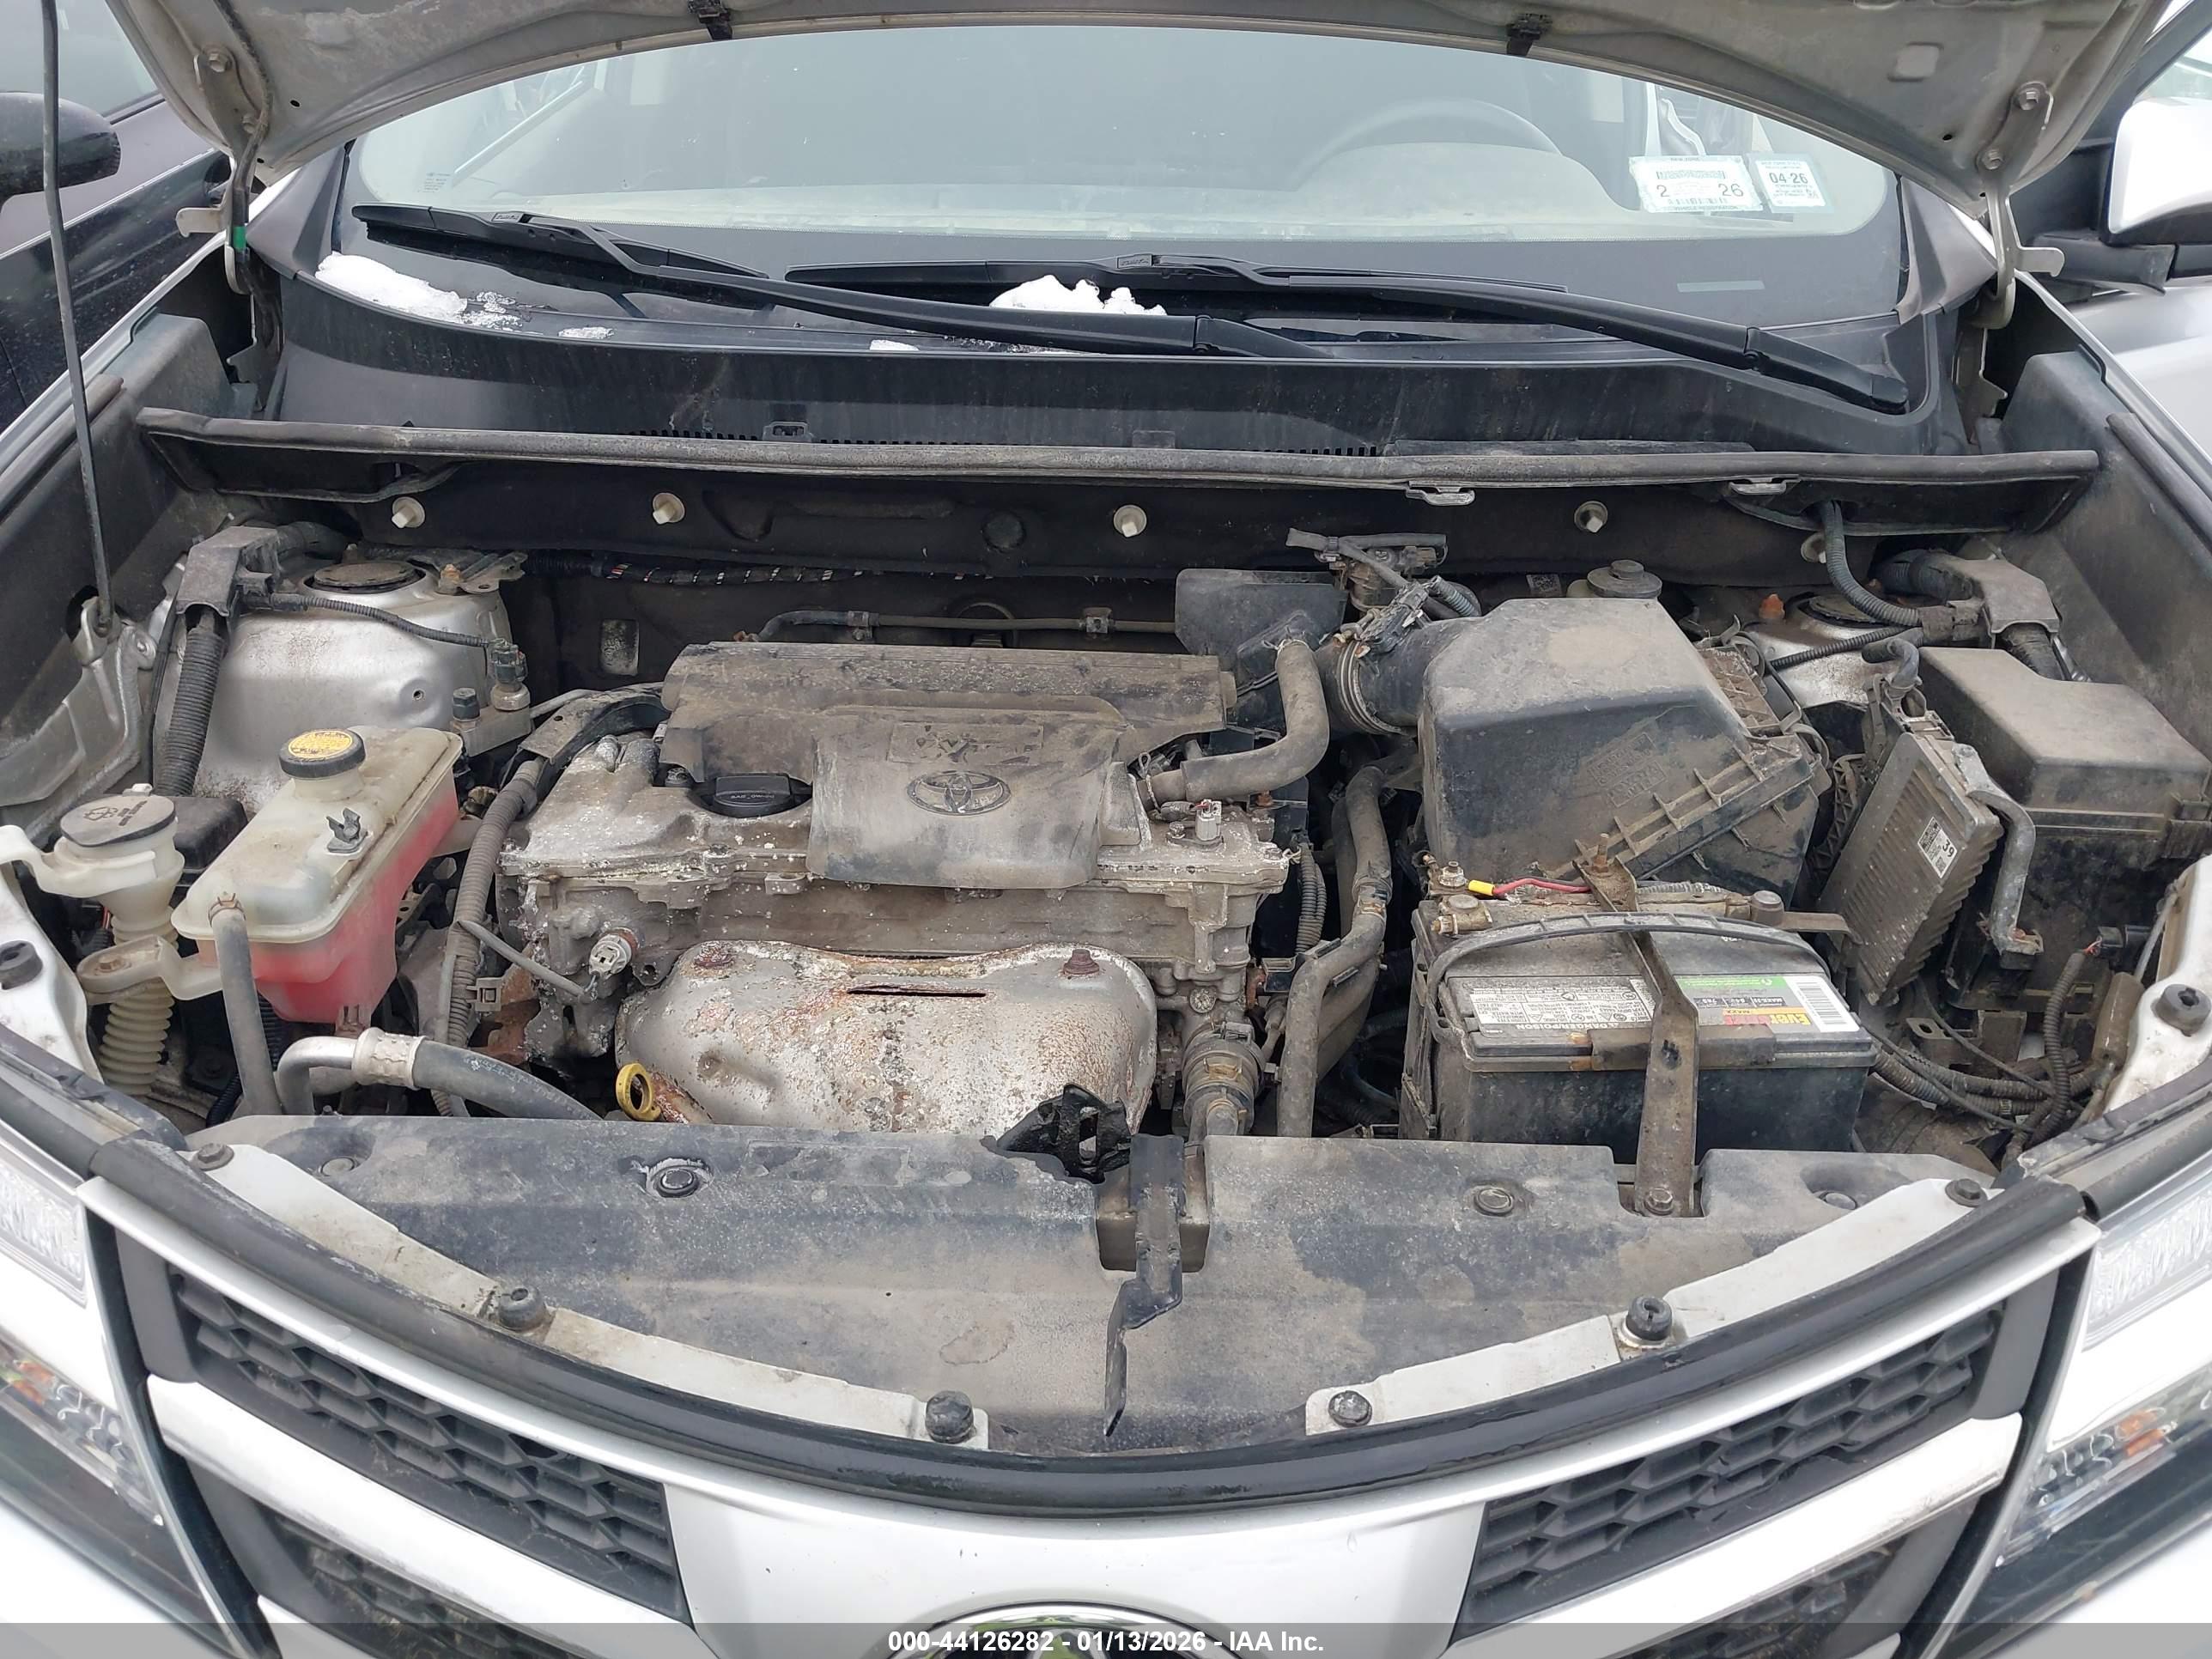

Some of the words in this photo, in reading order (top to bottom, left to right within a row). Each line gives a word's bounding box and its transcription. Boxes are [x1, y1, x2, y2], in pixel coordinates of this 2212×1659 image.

[1656, 185, 1670, 198] 2
[1718, 184, 1744, 197] 26
[1942, 838, 1954, 857] 39
